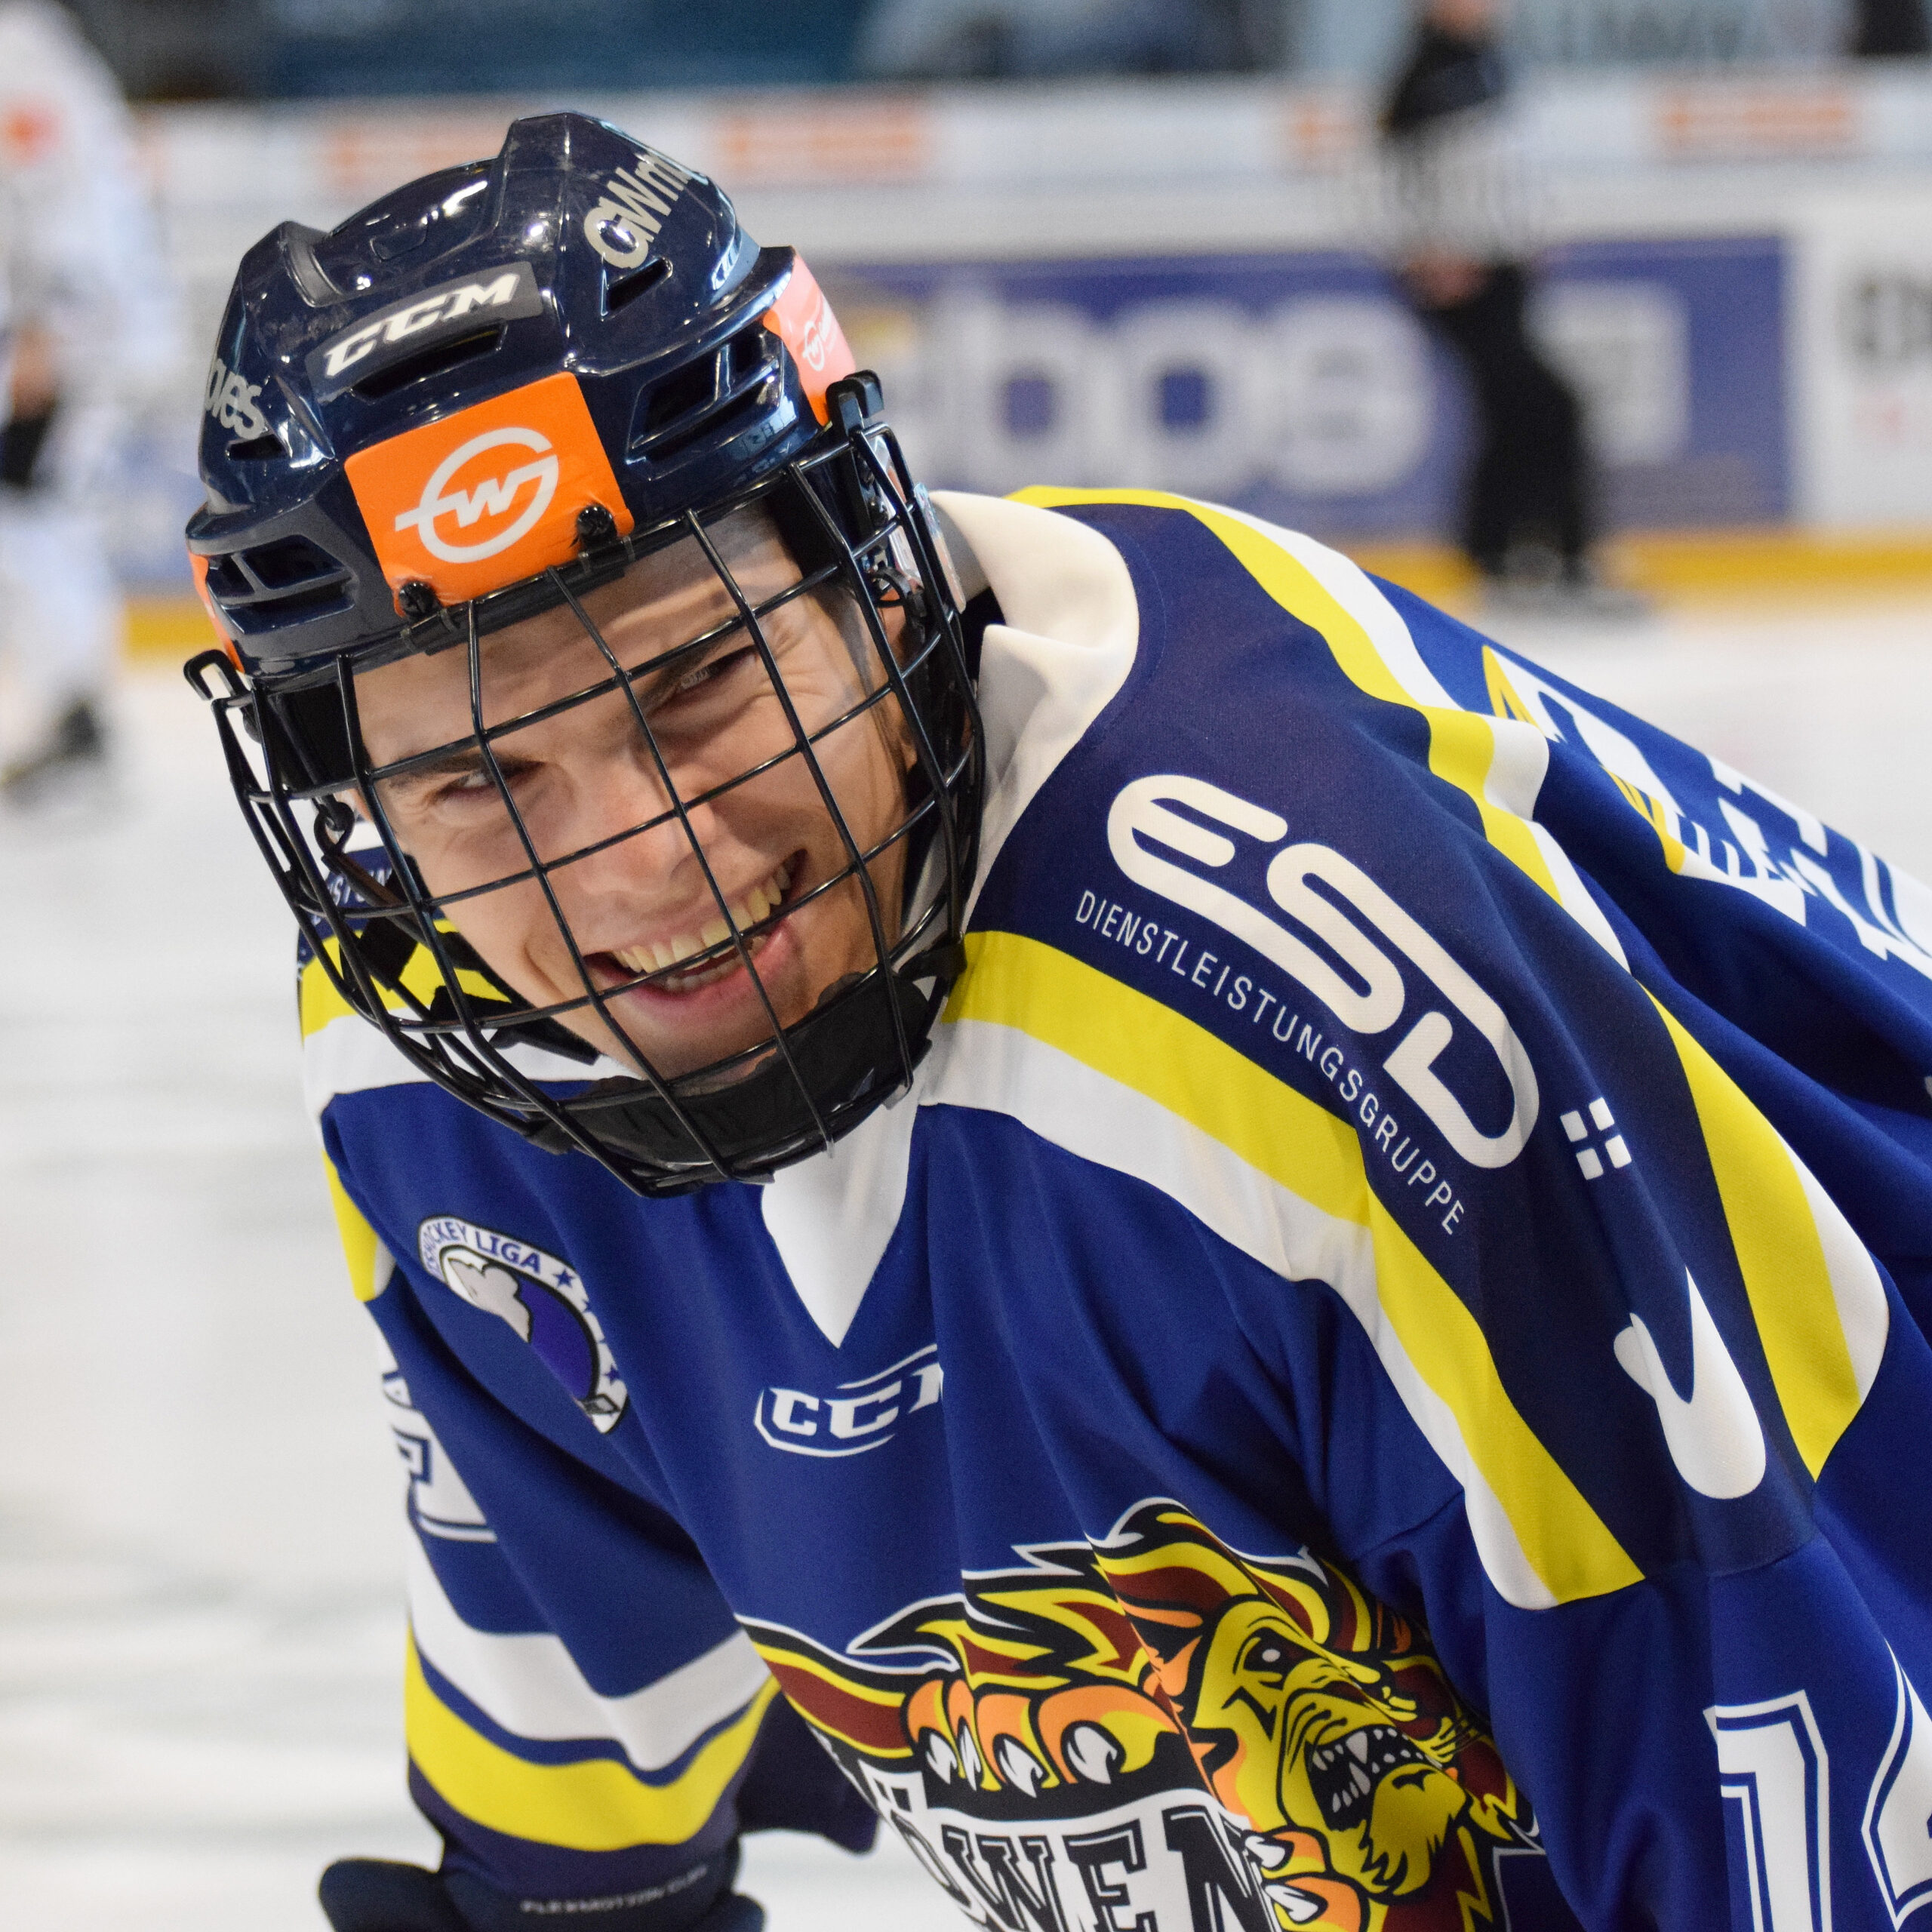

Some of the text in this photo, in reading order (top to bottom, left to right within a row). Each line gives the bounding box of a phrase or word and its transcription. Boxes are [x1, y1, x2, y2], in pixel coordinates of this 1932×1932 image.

[324, 272, 520, 377] CCM
[1074, 889, 1465, 1235] DIENSTLEISTUNGSGRUPPE
[1106, 774, 1540, 1170] ESD
[474, 1229, 542, 1275] LIGA
